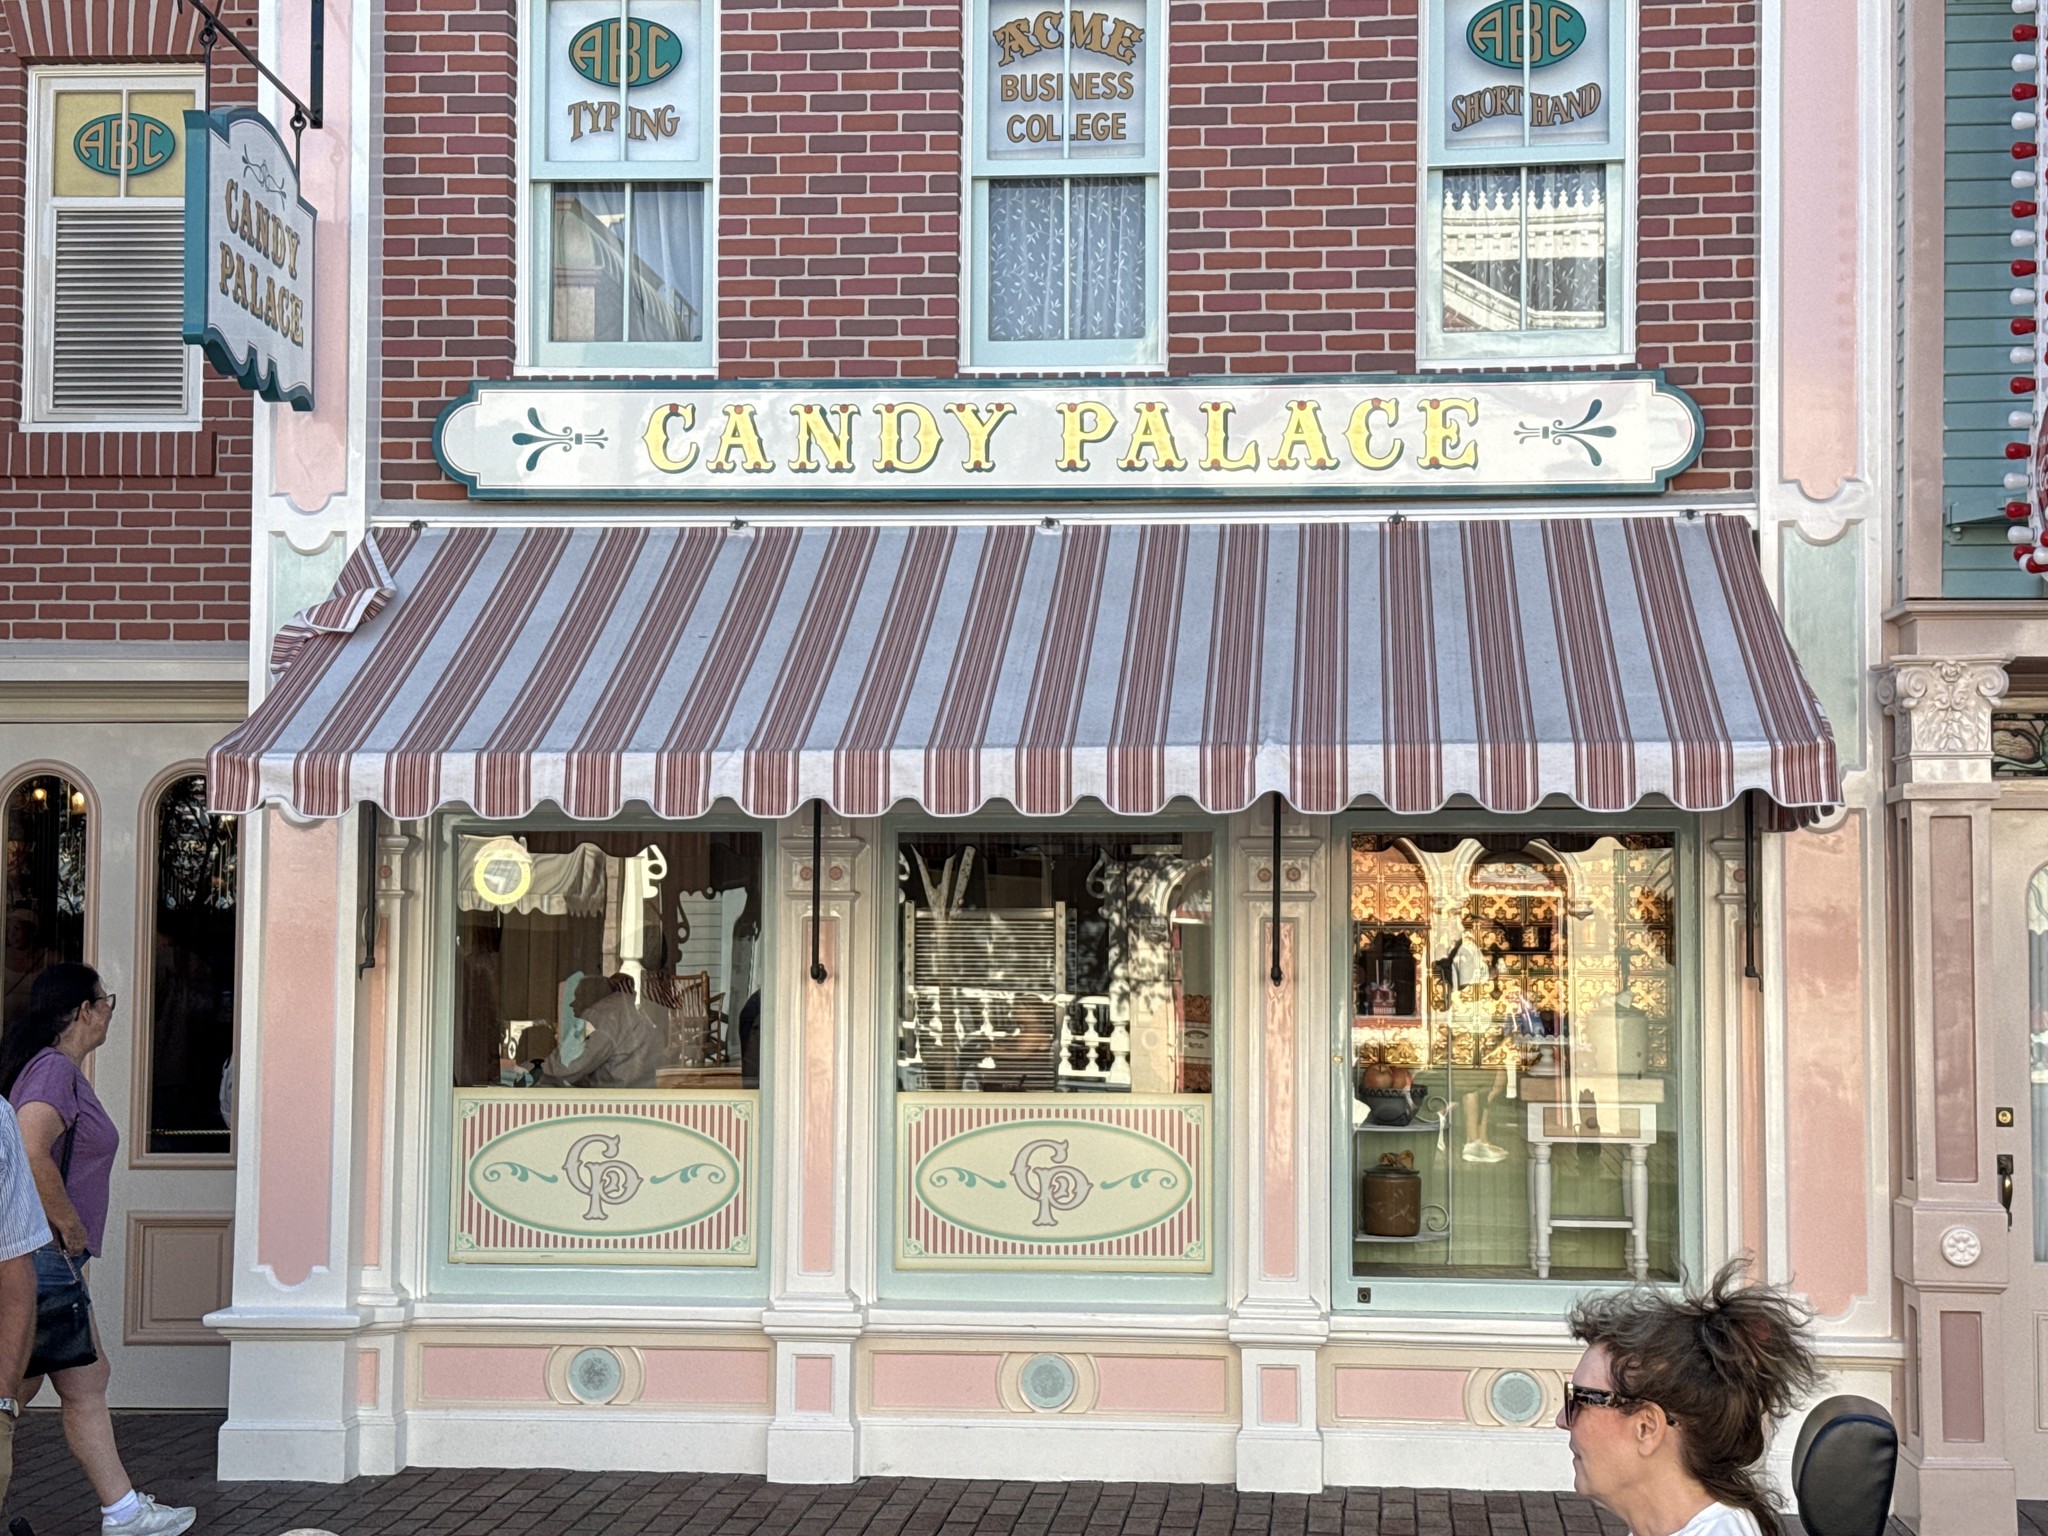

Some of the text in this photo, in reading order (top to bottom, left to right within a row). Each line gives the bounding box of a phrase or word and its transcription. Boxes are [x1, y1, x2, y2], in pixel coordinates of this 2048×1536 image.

[572, 21, 672, 84] ABC
[993, 10, 1145, 67] ACME
[1471, 2, 1575, 64] ABC
[1001, 71, 1134, 102] BUSINESS
[79, 118, 165, 170] ABC
[568, 100, 680, 142] TYPING
[225, 178, 300, 281] CANDY
[219, 241, 303, 348] PALACE
[642, 397, 1479, 473] CANDY PALACE
